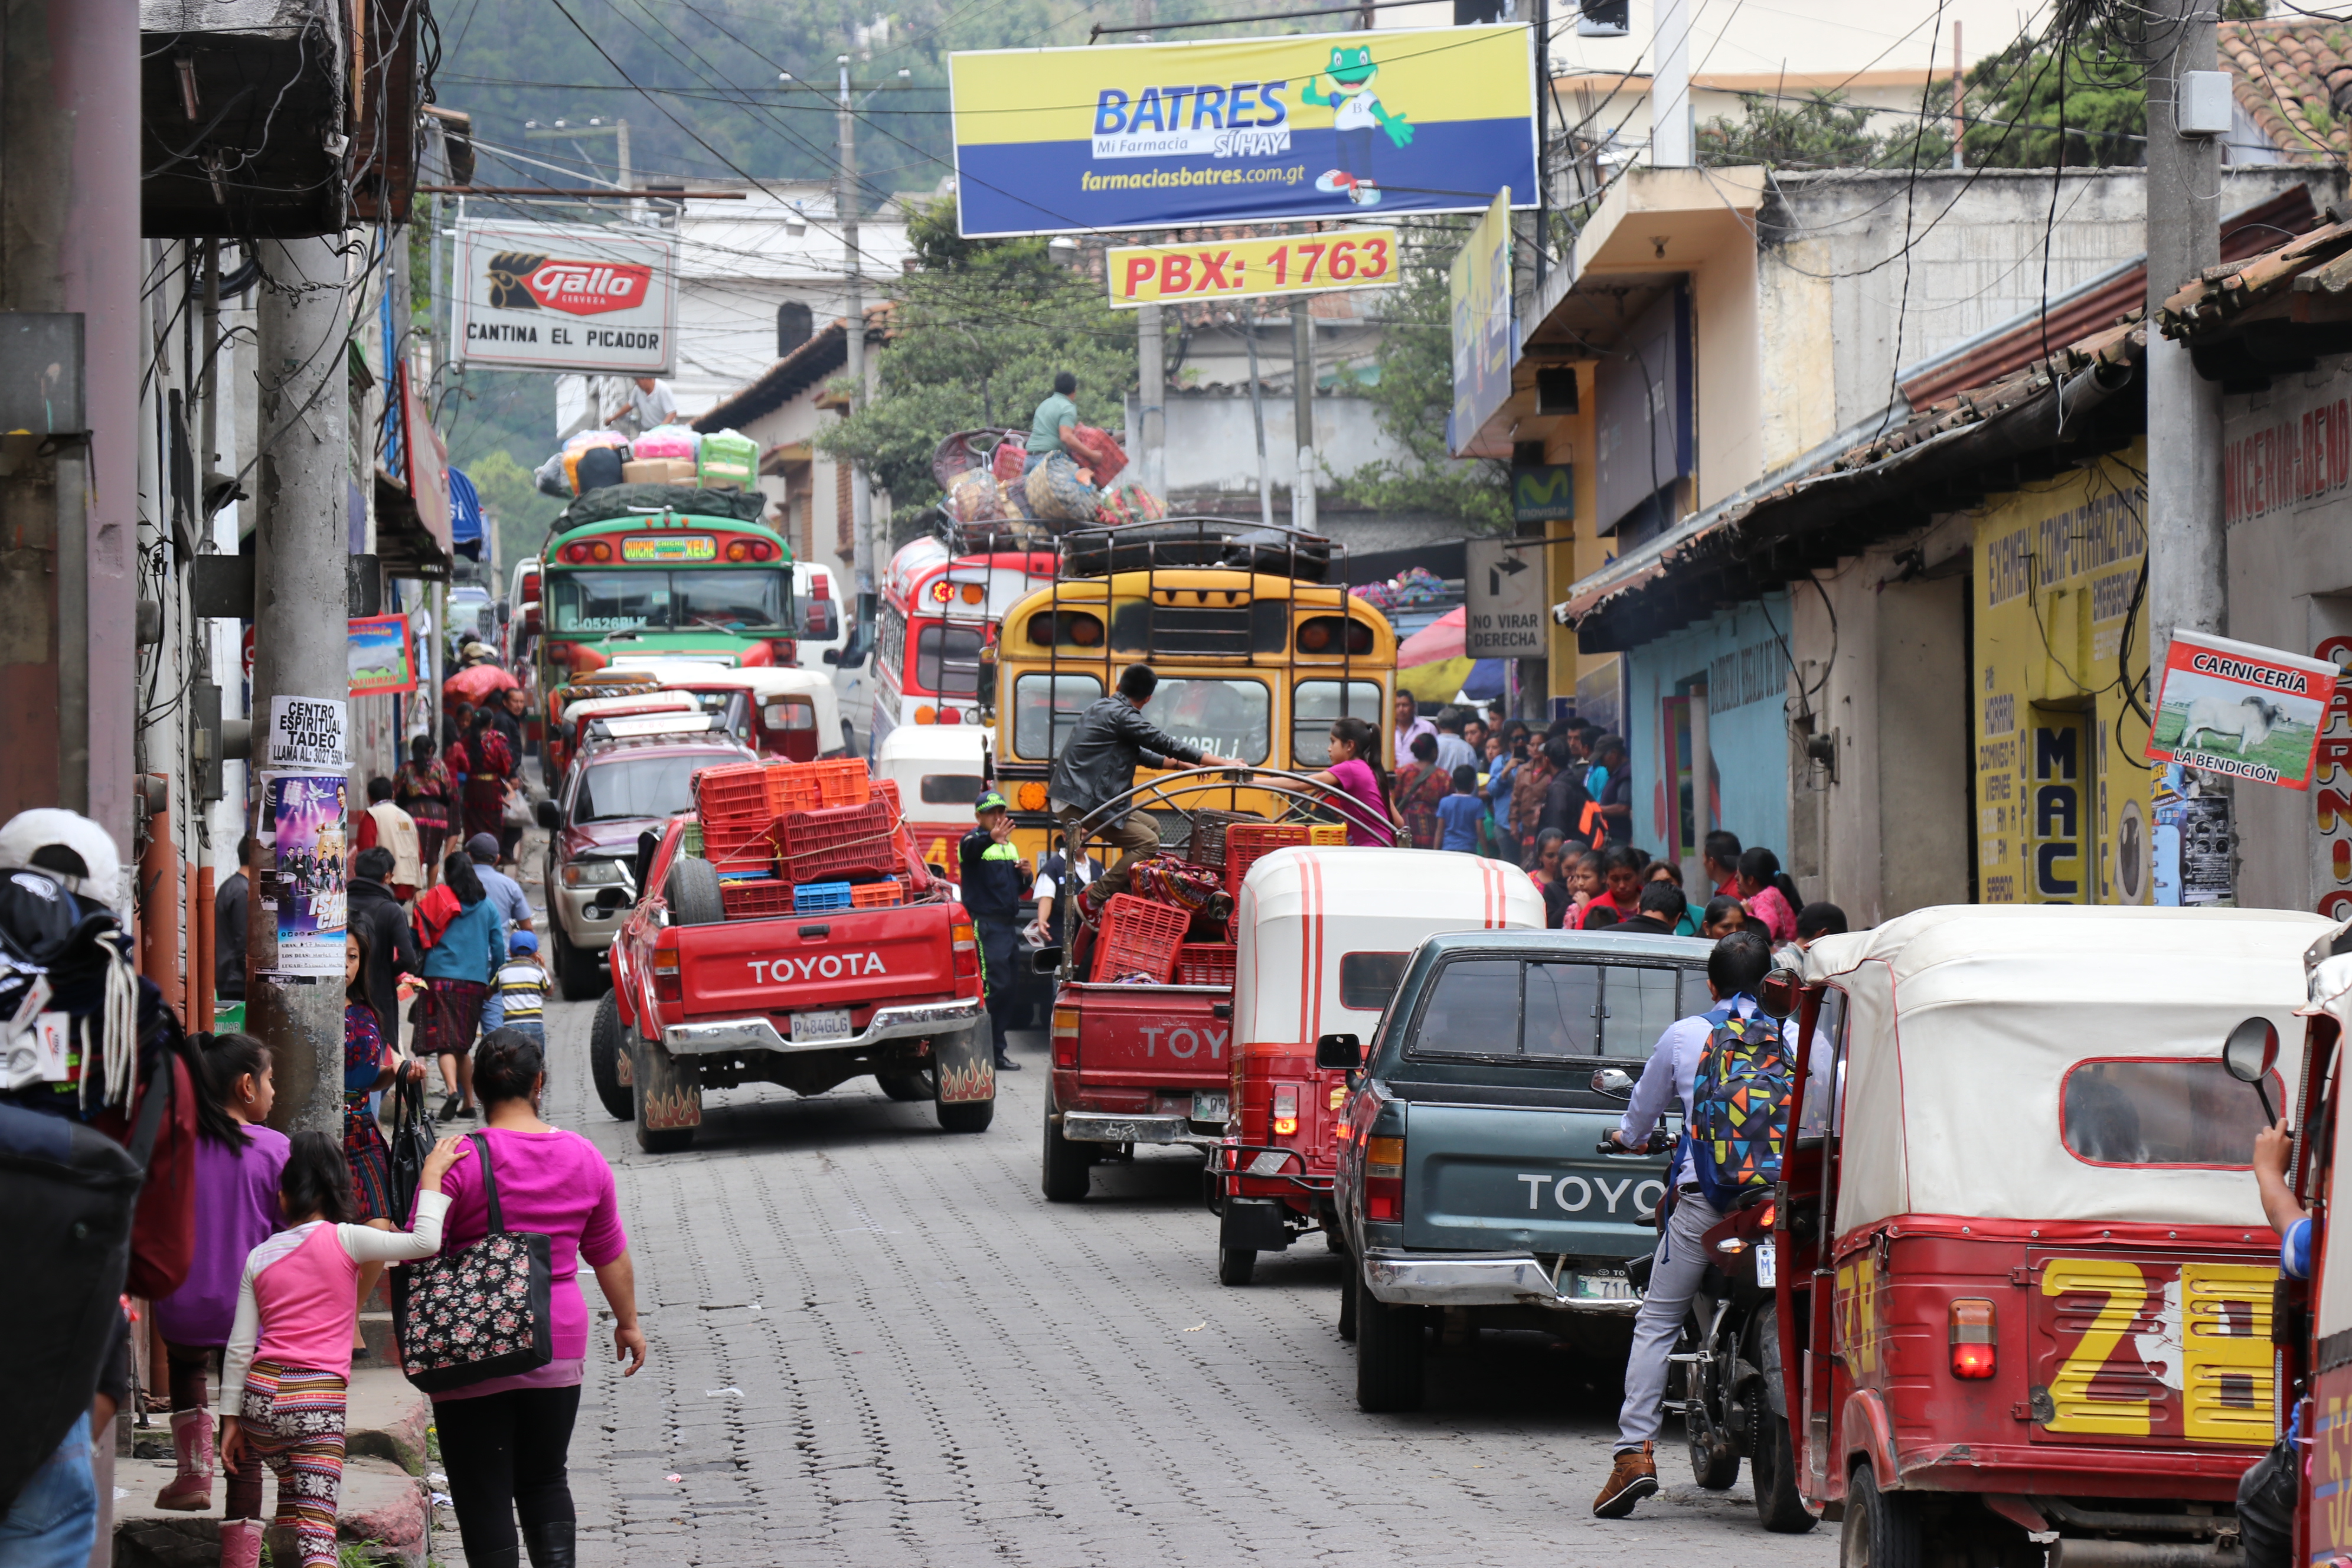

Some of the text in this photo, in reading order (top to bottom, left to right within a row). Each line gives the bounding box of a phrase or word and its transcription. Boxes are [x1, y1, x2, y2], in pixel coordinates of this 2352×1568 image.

[1093, 80, 1288, 135] BATRES
[1352, 102, 1362, 113] B
[1097, 141, 1115, 153] Mi
[1119, 138, 1188, 152] Farmacia
[1082, 165, 1305, 191] farmaciasbatres.com.gt
[1125, 237, 1389, 298] PBX: 1763
[562, 295, 606, 305] CERVEZA
[466, 322, 659, 350] CANTINA EL PICADOR
[1518, 507, 1569, 518] movistar
[624, 541, 655, 558] QUICHE
[685, 539, 716, 557] XELA
[1988, 485, 2144, 609] EXAMEN COMPUTARIZADO
[1474, 613, 1538, 629] NO VIRAR
[1475, 632, 1537, 647] DERECHA
[2194, 654, 2306, 692] CARNICERÍA
[288, 701, 334, 719] CENTRO
[1984, 693, 2014, 737] HORARIO
[280, 714, 341, 735] ESPIRITUAL
[288, 730, 336, 749] TADEO
[273, 744, 298, 761] LLAMA
[300, 746, 311, 762] AL:
[314, 747, 330, 764] 3027
[2010, 740, 2015, 766] A
[2174, 749, 2278, 782] LA BENDICIÓN
[1985, 773, 2011, 802] VIERNES
[2011, 805, 2016, 831] A
[2034, 727, 2077, 904] MAC
[1987, 875, 2013, 903] SABADO
[747, 952, 887, 984] TOYOTA
